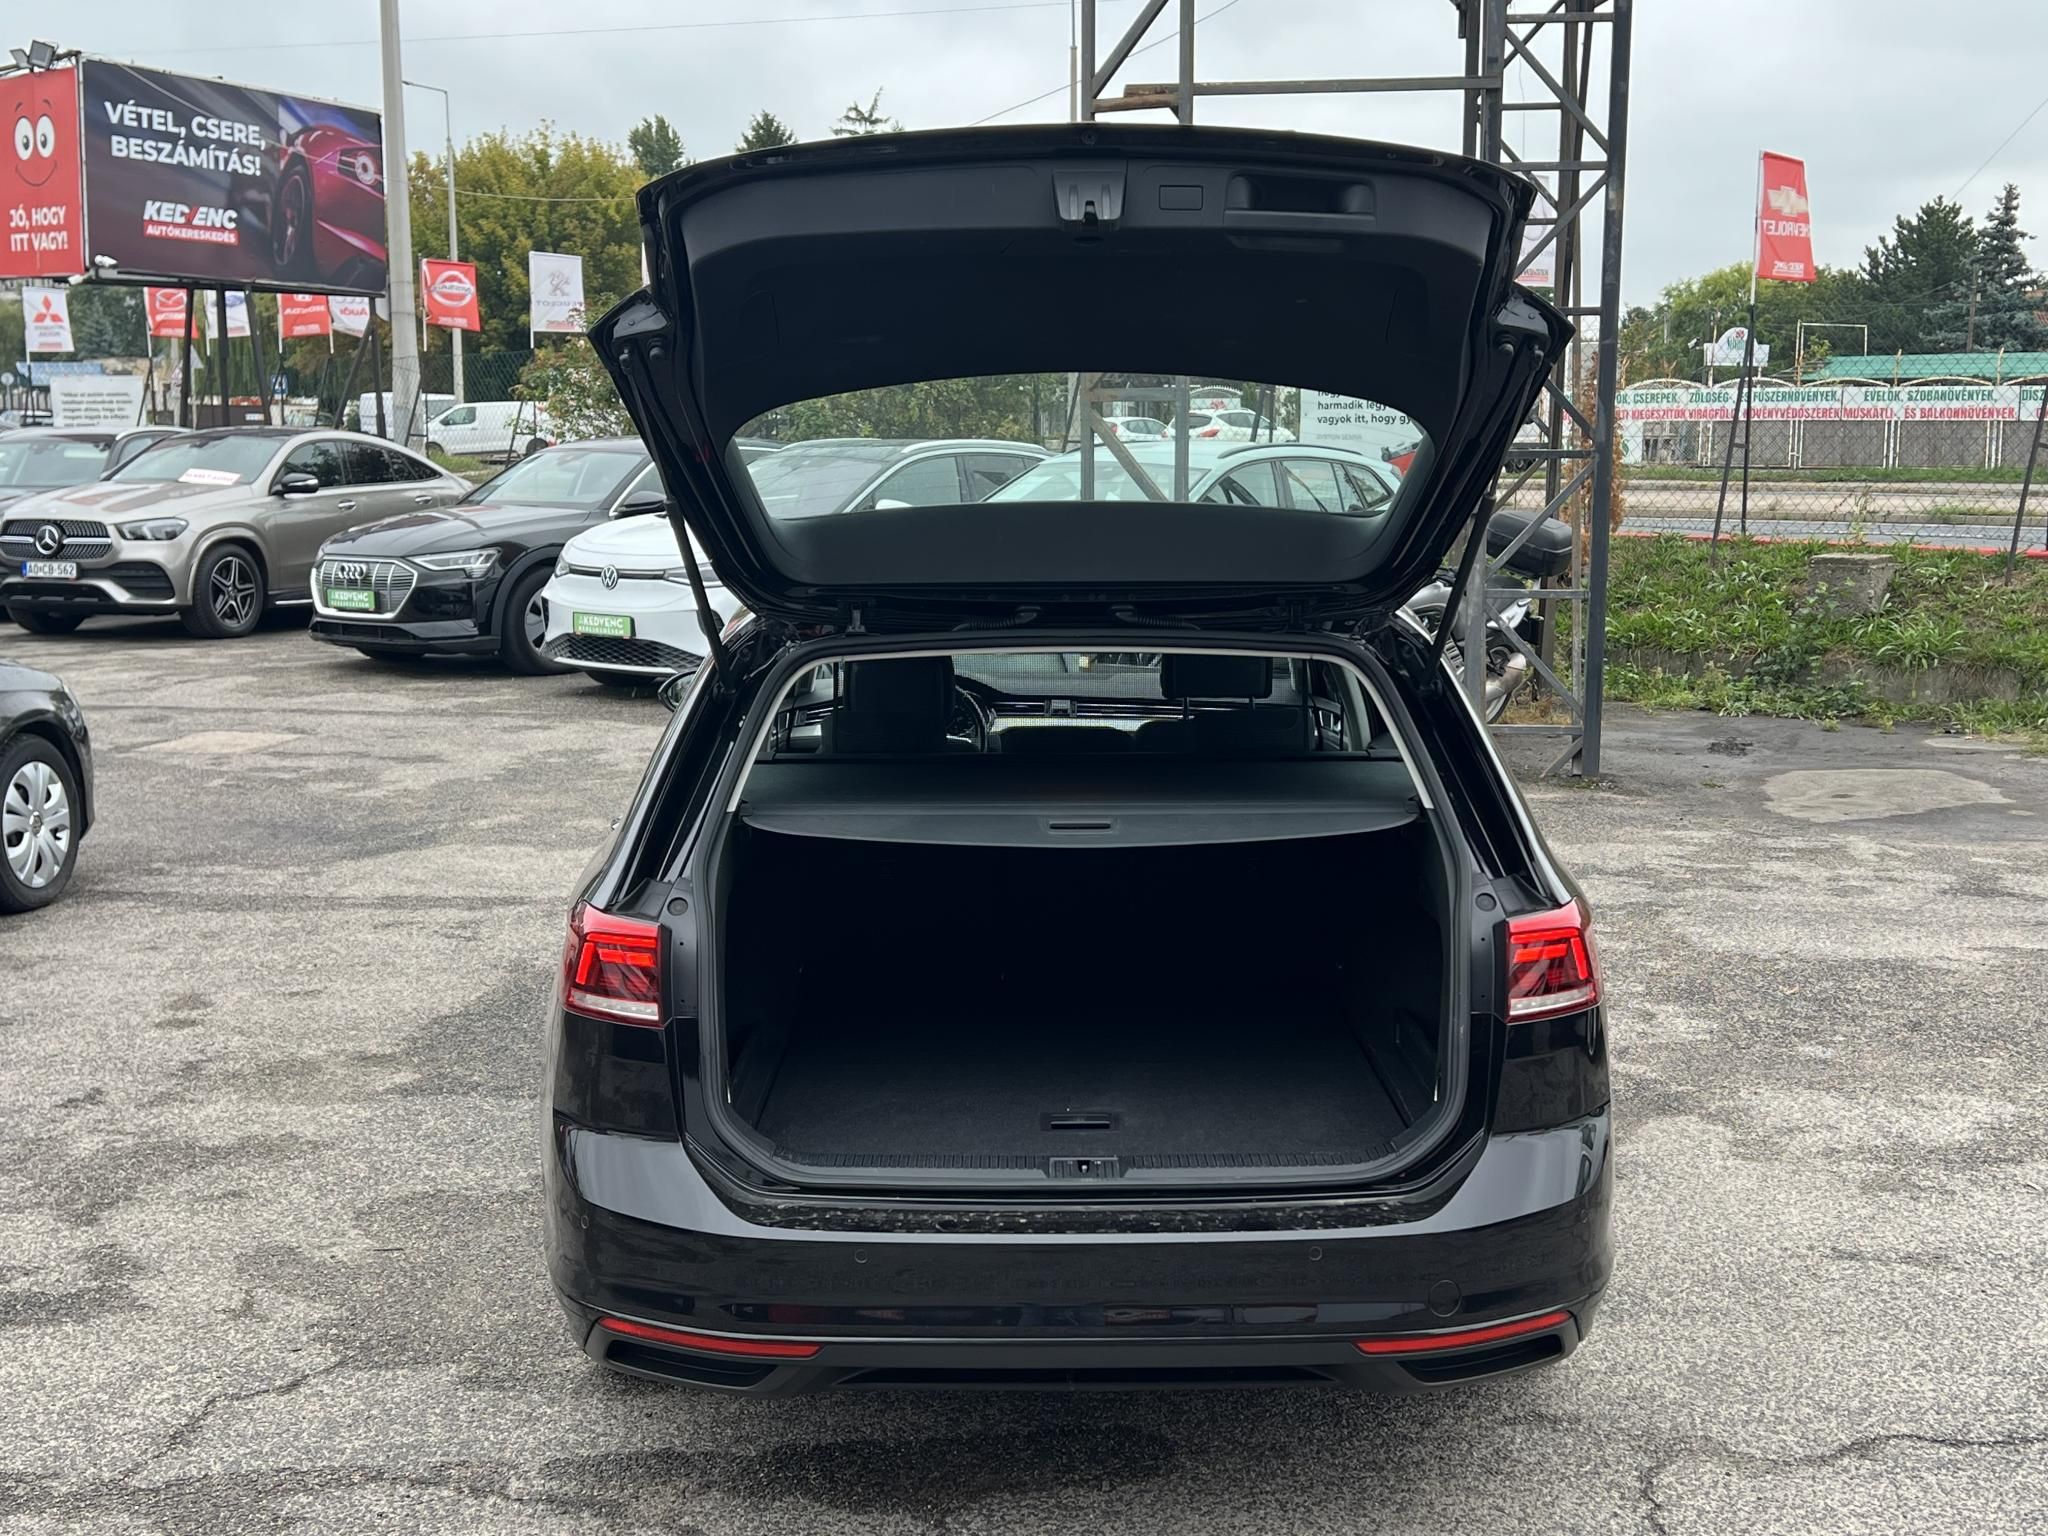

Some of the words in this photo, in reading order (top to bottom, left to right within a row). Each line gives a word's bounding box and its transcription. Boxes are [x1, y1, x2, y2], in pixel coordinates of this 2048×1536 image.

[104, 100, 186, 138] VÉTEL,
[191, 115, 266, 151] CSERE,
[111, 135, 262, 176] BESZÁMÍTÁS!
[9, 203, 30, 231] JÓ,
[31, 205, 66, 227] HOGY
[10, 232, 29, 252] ITT
[31, 230, 68, 251] VAGY!
[1317, 401, 1363, 410] harmadik
[1904, 406, 1916, 419] ÉS
[1317, 415, 1352, 426] vagyok
[1354, 414, 1368, 424] itt,
[1371, 414, 1397, 425] hogy
